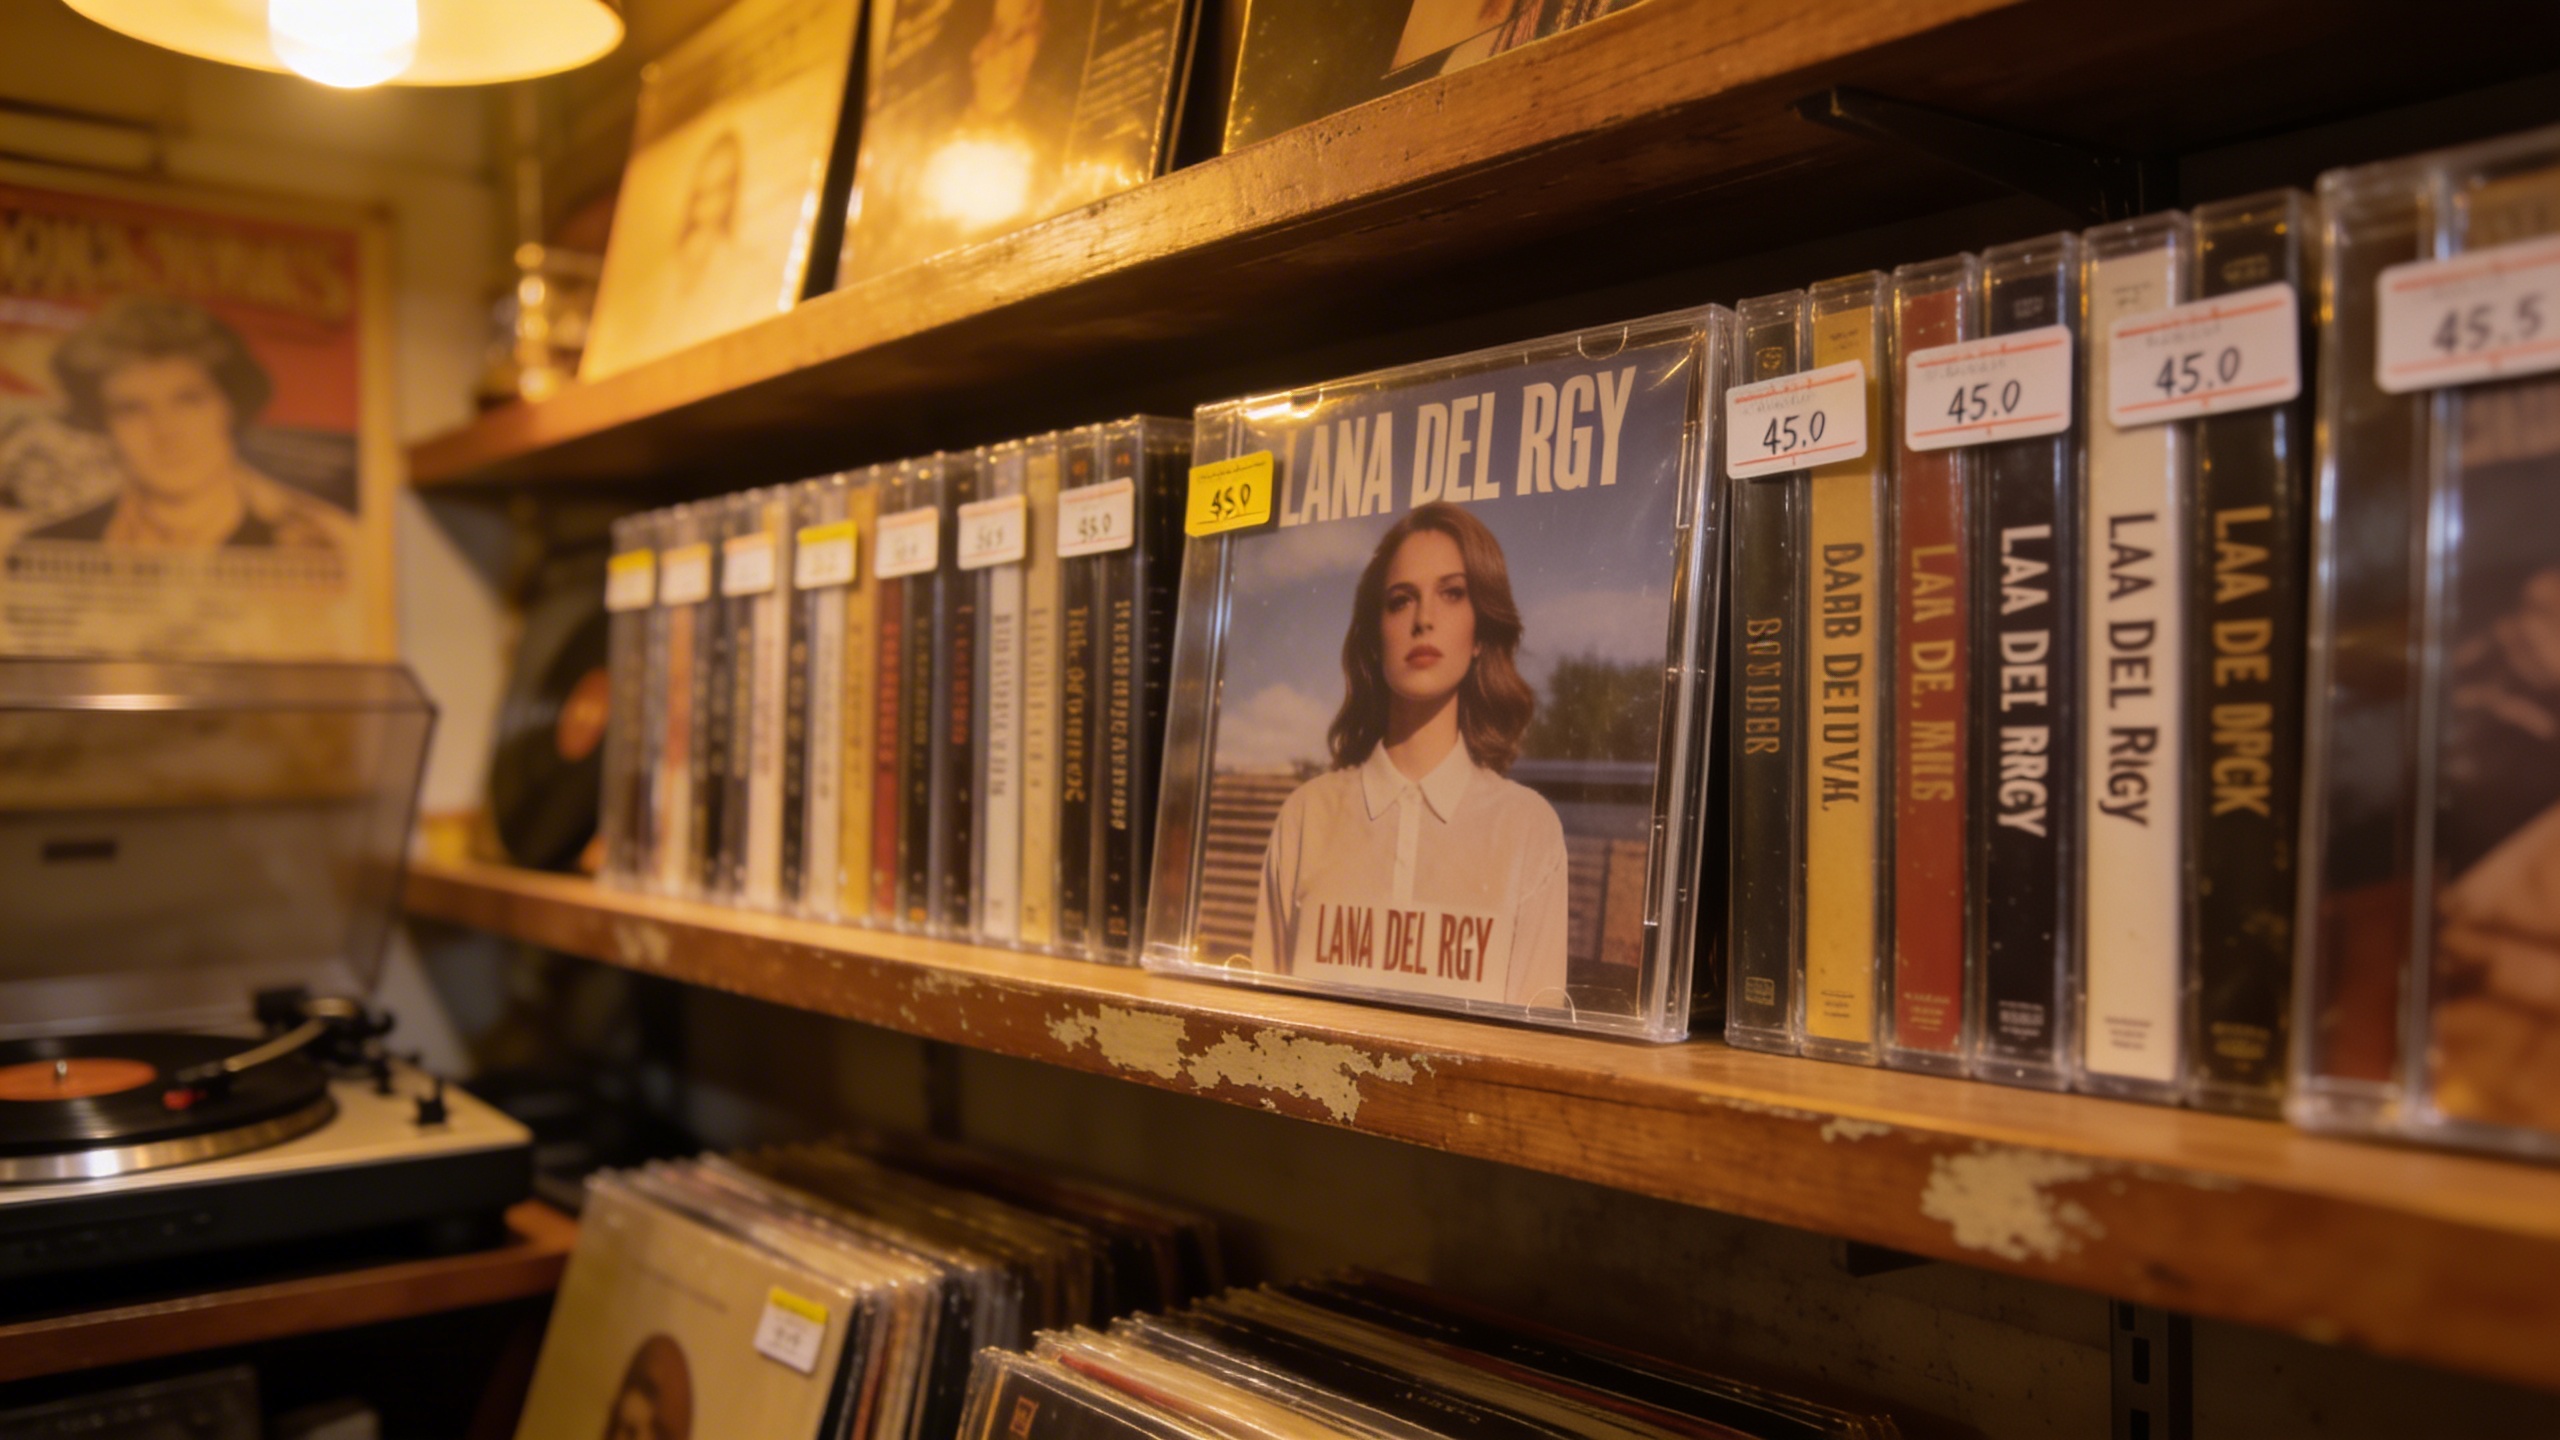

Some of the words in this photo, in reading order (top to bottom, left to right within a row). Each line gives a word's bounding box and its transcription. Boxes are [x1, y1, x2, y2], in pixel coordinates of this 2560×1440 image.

[2433, 294, 2545, 353] 45.5
[1948, 379, 2021, 424] 45.0
[2156, 346, 2242, 397] 45.0
[1279, 411, 1393, 528] LANA
[1410, 392, 1500, 509] DEL
[1516, 366, 1637, 496] RGY
[1763, 410, 1826, 455] 45.0
[2001, 524, 2050, 615] LAA
[2108, 513, 2156, 601] LAA
[2213, 506, 2271, 603] LAA
[2108, 620, 2156, 709] DEL
[2212, 618, 2271, 687] DE
[1315, 903, 1374, 969] LANA
[1382, 909, 1428, 976] DEL
[1437, 913, 1495, 983] RGY
